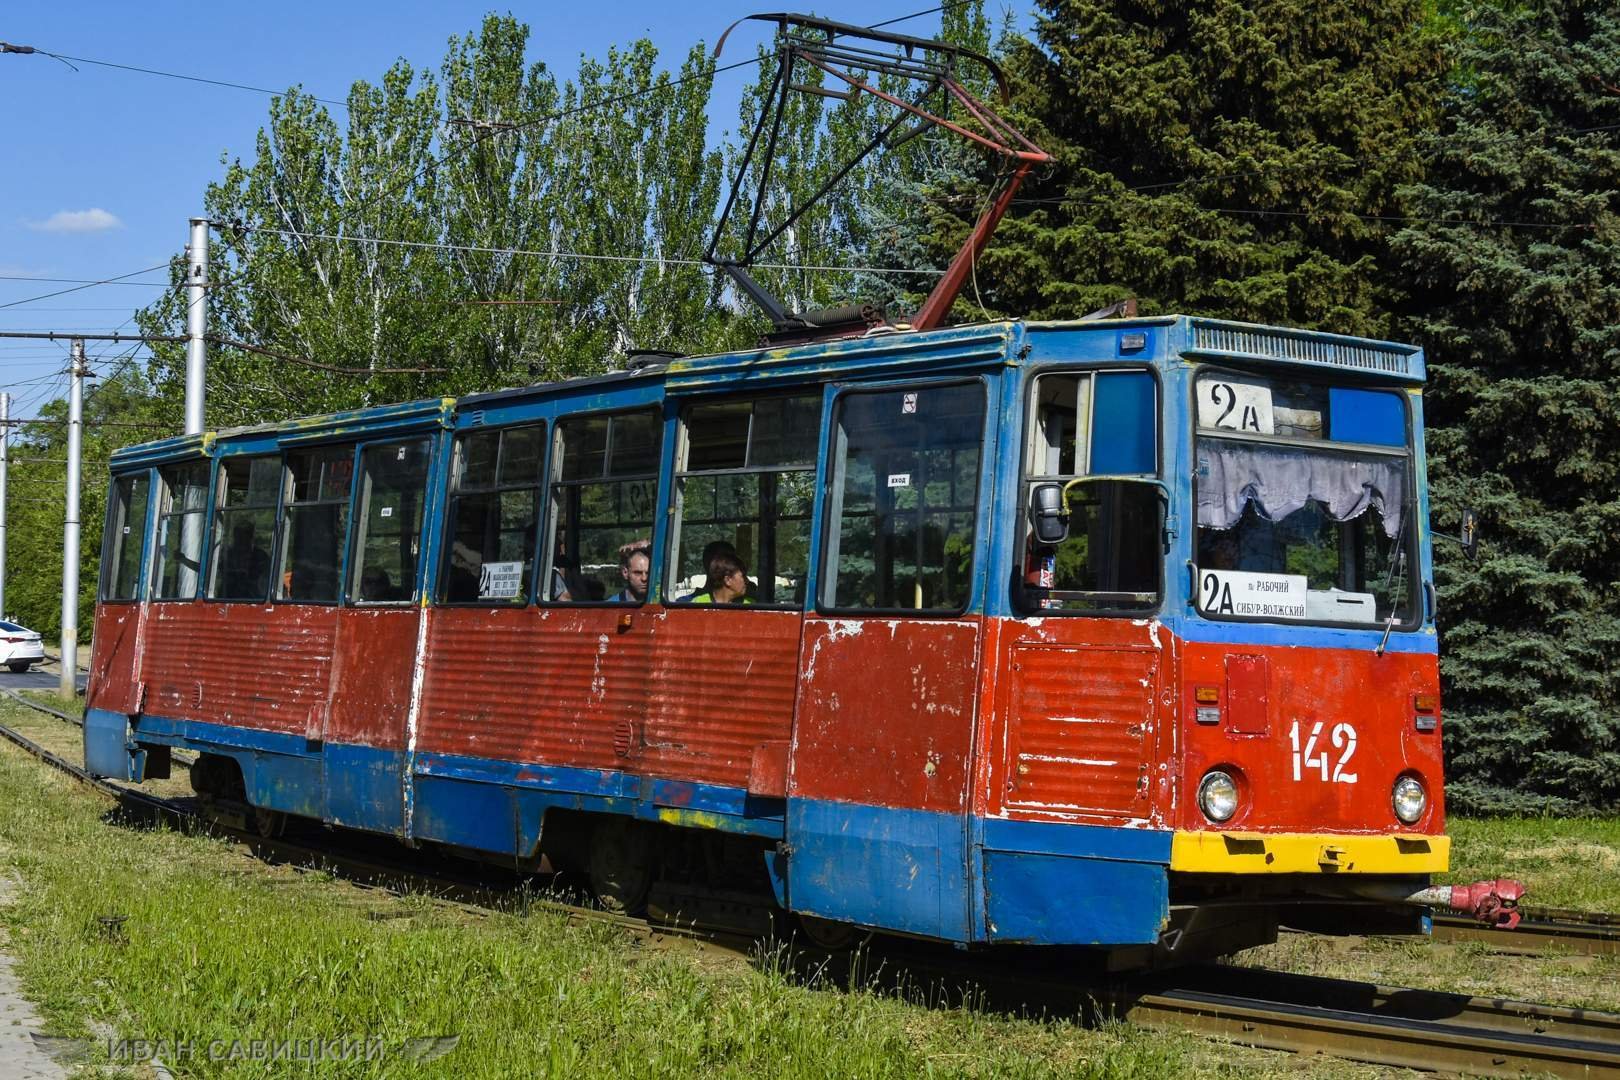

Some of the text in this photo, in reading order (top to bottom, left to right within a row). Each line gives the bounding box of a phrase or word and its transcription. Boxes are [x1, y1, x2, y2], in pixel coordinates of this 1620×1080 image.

[1256, 580, 1289, 593] РАБОЧИЙ
[1236, 602, 1305, 617] СИБУР-ВОЛЖСКИЙ
[1289, 719, 1358, 783] 142
